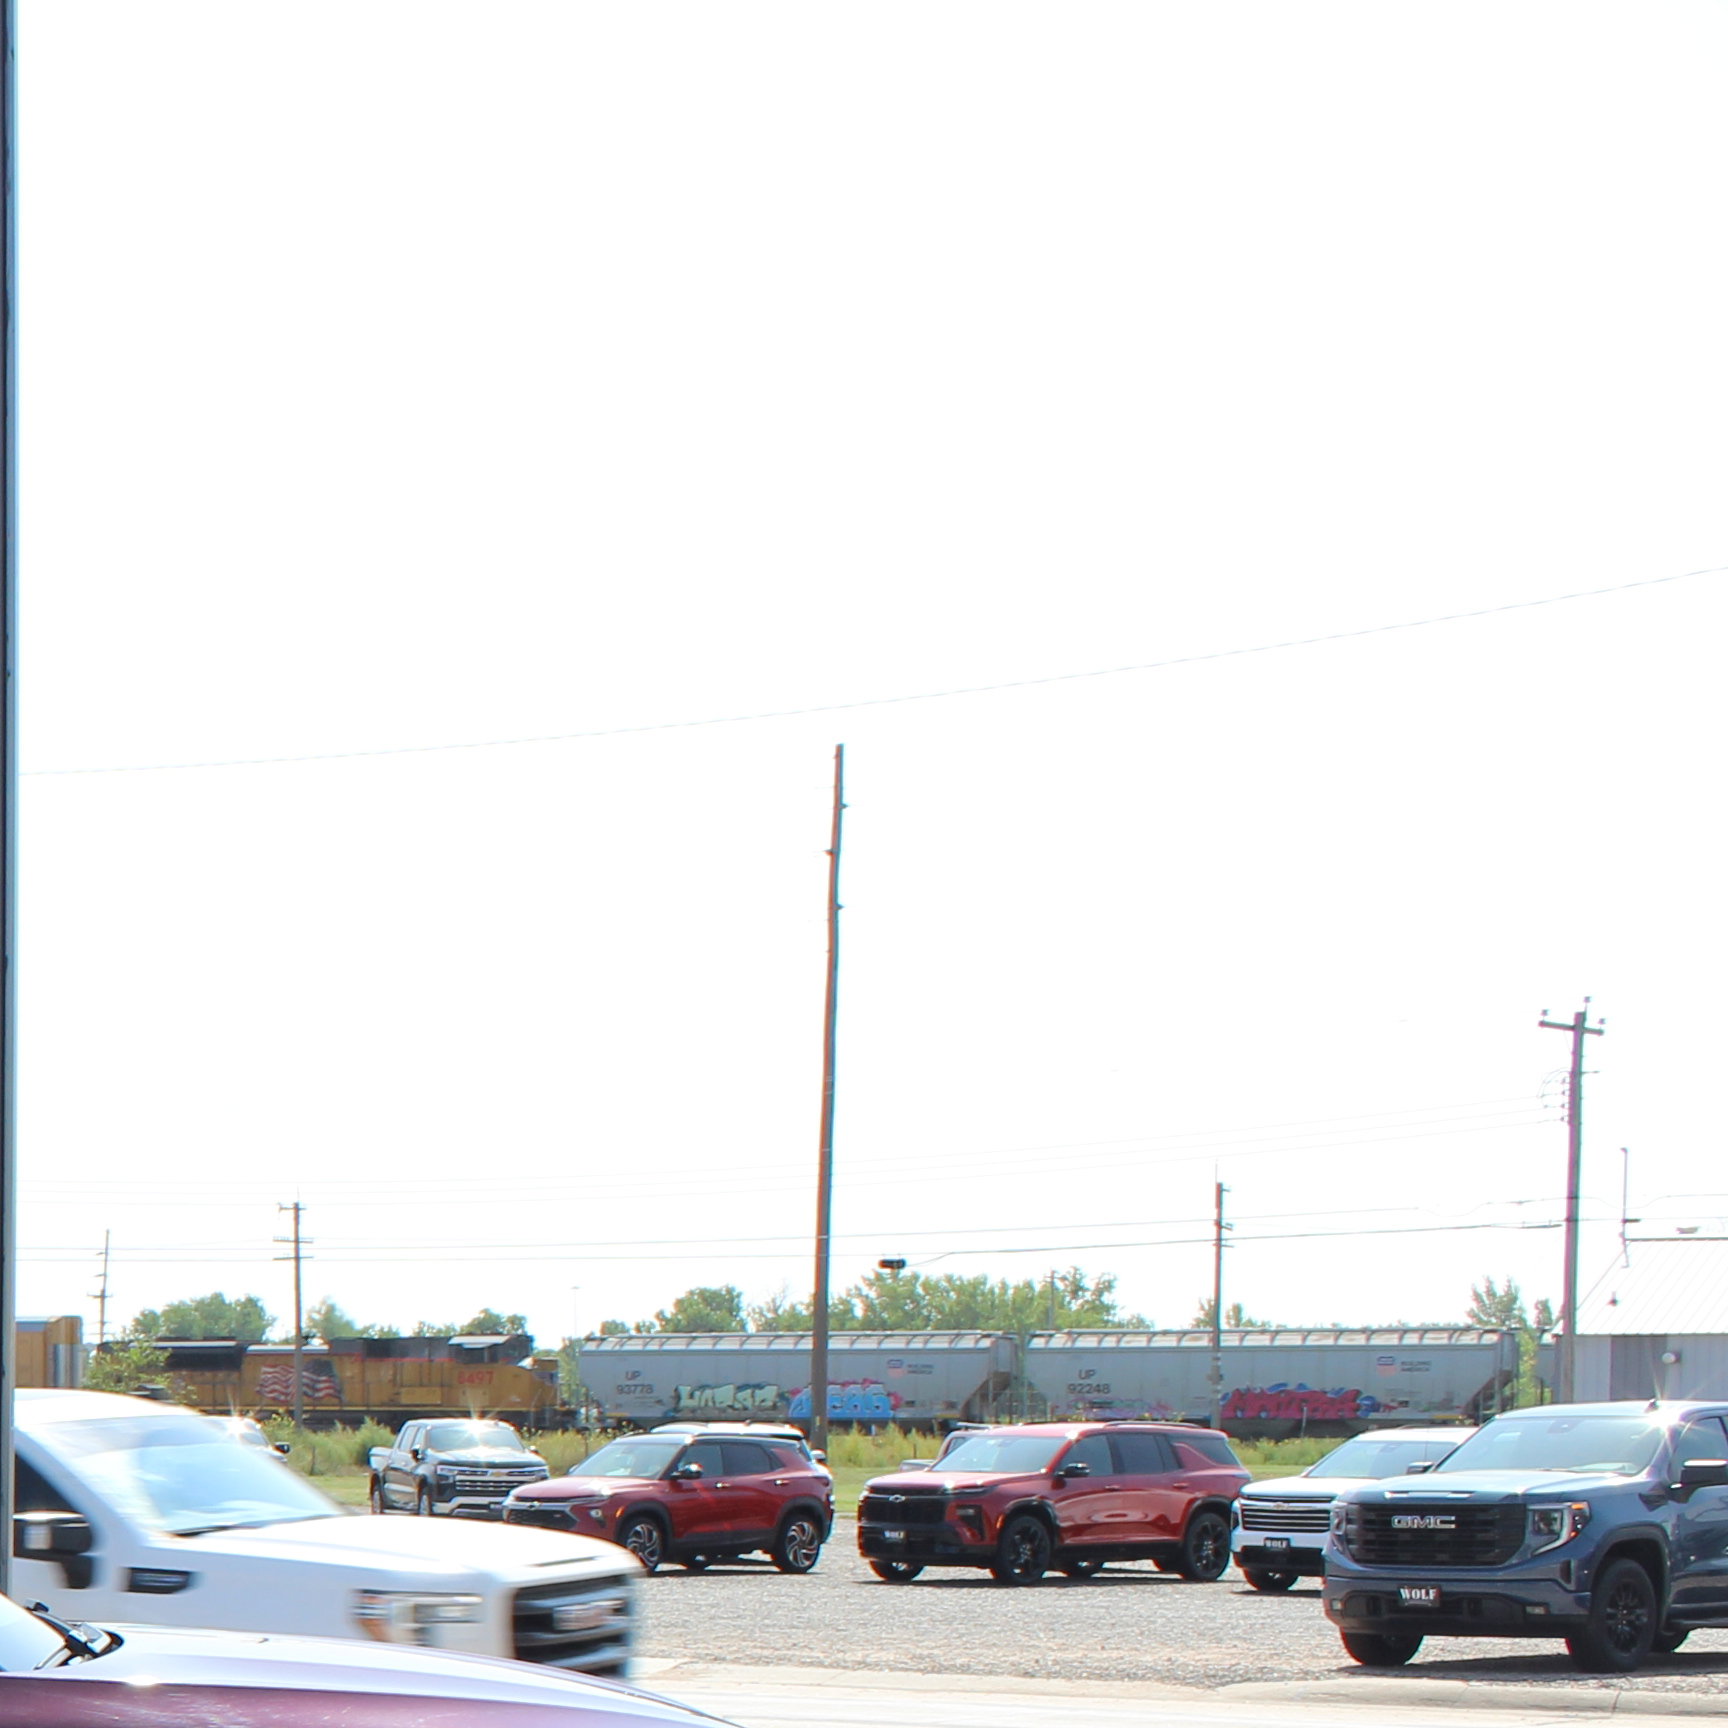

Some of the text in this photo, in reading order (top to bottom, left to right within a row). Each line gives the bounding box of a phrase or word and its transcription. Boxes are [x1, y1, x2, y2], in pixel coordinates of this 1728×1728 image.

[625, 1370, 641, 1380] UP
[1077, 1369, 1096, 1380] UP
[1068, 1383, 1111, 1394] 92248
[1391, 1516, 1456, 1529] GMC
[1399, 1588, 1437, 1600] WOLF
